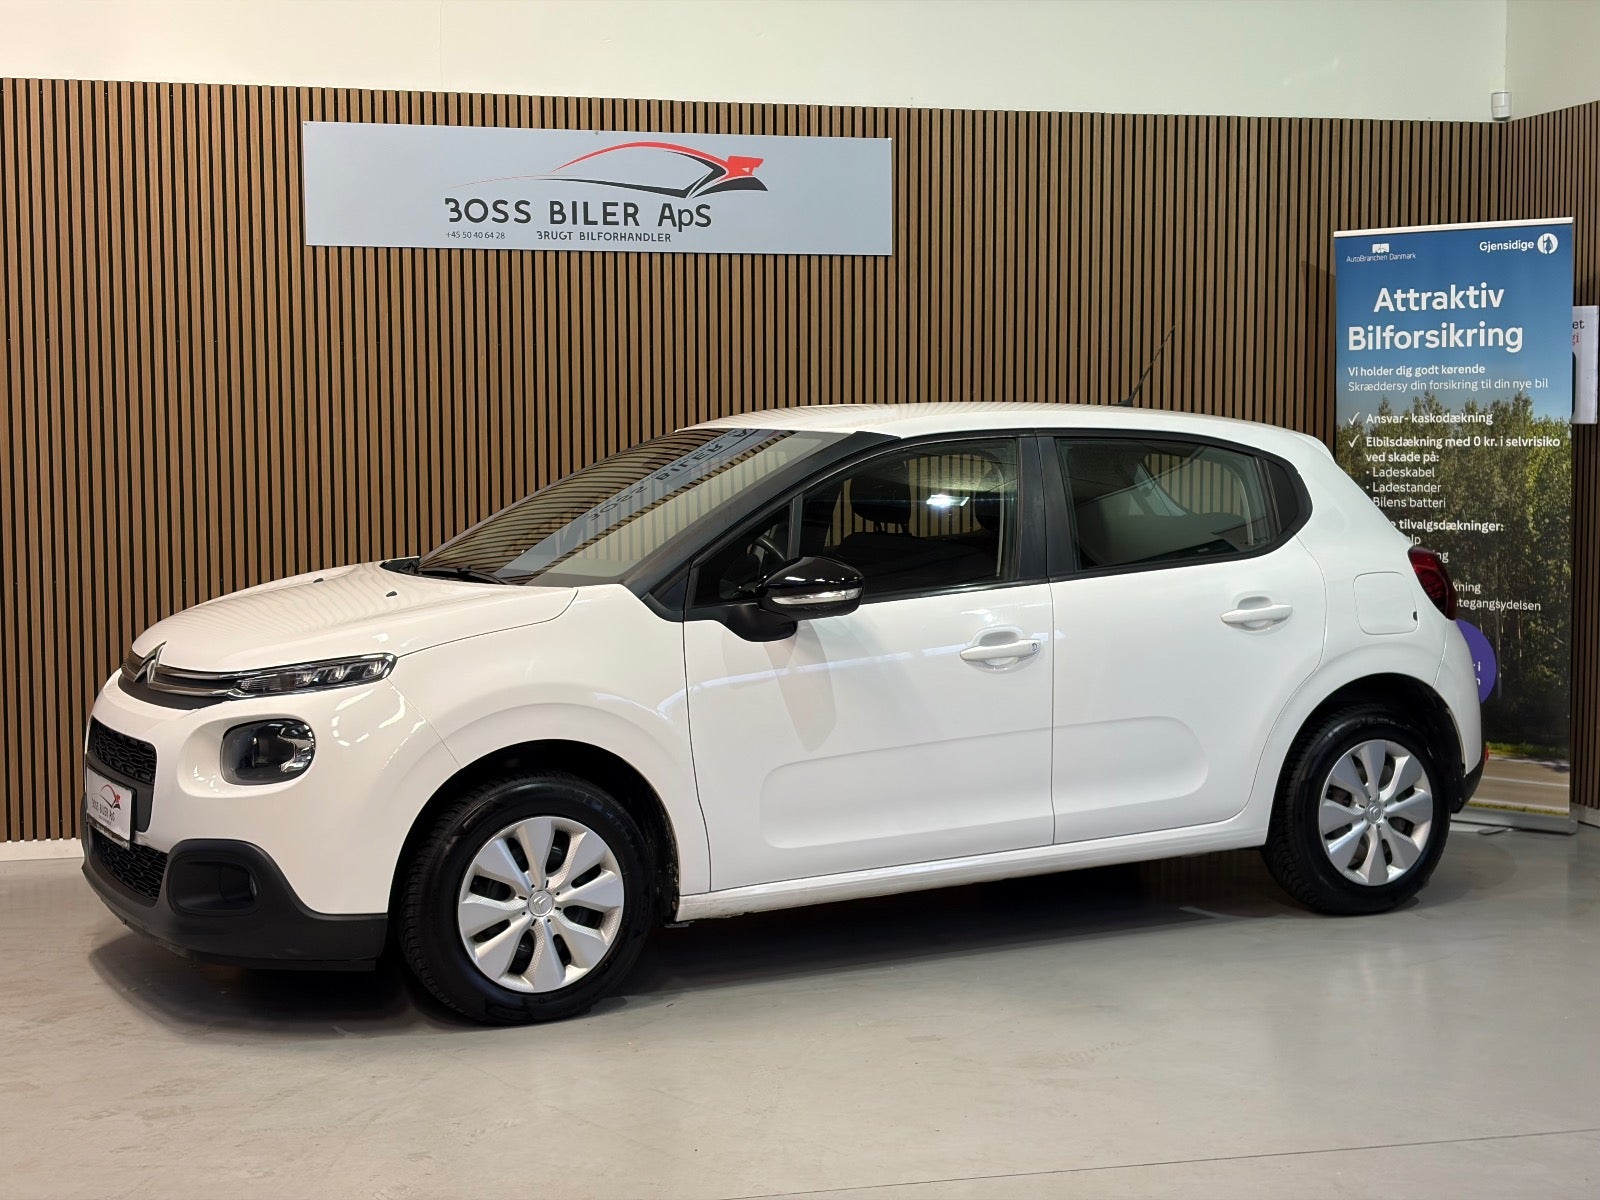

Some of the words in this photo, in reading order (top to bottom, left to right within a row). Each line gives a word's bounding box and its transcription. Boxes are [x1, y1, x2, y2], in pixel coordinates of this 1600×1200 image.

[444, 198, 532, 224] BOSS
[549, 200, 640, 227] BILER
[657, 203, 712, 232] ApS
[462, 231, 472, 239] 50
[473, 231, 483, 239] 40
[484, 231, 494, 239] 64
[495, 232, 506, 240] 28
[536, 231, 573, 241] BRUGT
[579, 232, 672, 242] BILFORHANDLER
[1479, 240, 1535, 252] Gjensidige
[1346, 253, 1388, 263] AutoBranchen
[1389, 252, 1417, 262] Danmark
[1373, 282, 1505, 313] Attraktiv
[1348, 321, 1524, 354] Bilforsikring
[1348, 366, 1359, 377] Vi
[1360, 366, 1394, 376] holder
[1395, 365, 1413, 378] dig
[1414, 365, 1440, 377] godt
[1441, 364, 1486, 376] kørende
[1348, 381, 1410, 394] Skræddersy
[1410, 380, 1427, 391] din
[1429, 380, 1478, 393] forsikring
[1481, 379, 1492, 390] til
[1494, 379, 1511, 389] din
[1513, 380, 1533, 392] nye
[1535, 377, 1549, 389] bil
[1366, 413, 1409, 424] Ansvar-
[1411, 412, 1494, 426] kaskodækning
[1366, 436, 1443, 449] Elbilsdækning
[1445, 436, 1471, 447] med
[1473, 436, 1481, 447] 0
[1484, 436, 1497, 447] kr.
[1500, 436, 1504, 447] i
[1505, 436, 1561, 447] selvrisiko
[1366, 452, 1386, 462] ved
[1388, 452, 1420, 462] skade
[1423, 451, 1440, 464] på:
[1372, 468, 1435, 478] Ladeskabel
[1372, 483, 1442, 493] Ladestander
[1373, 497, 1407, 508] Bilens
[1409, 497, 1446, 509] batteri
[1399, 519, 1504, 534] tilvalgsdækninger:
